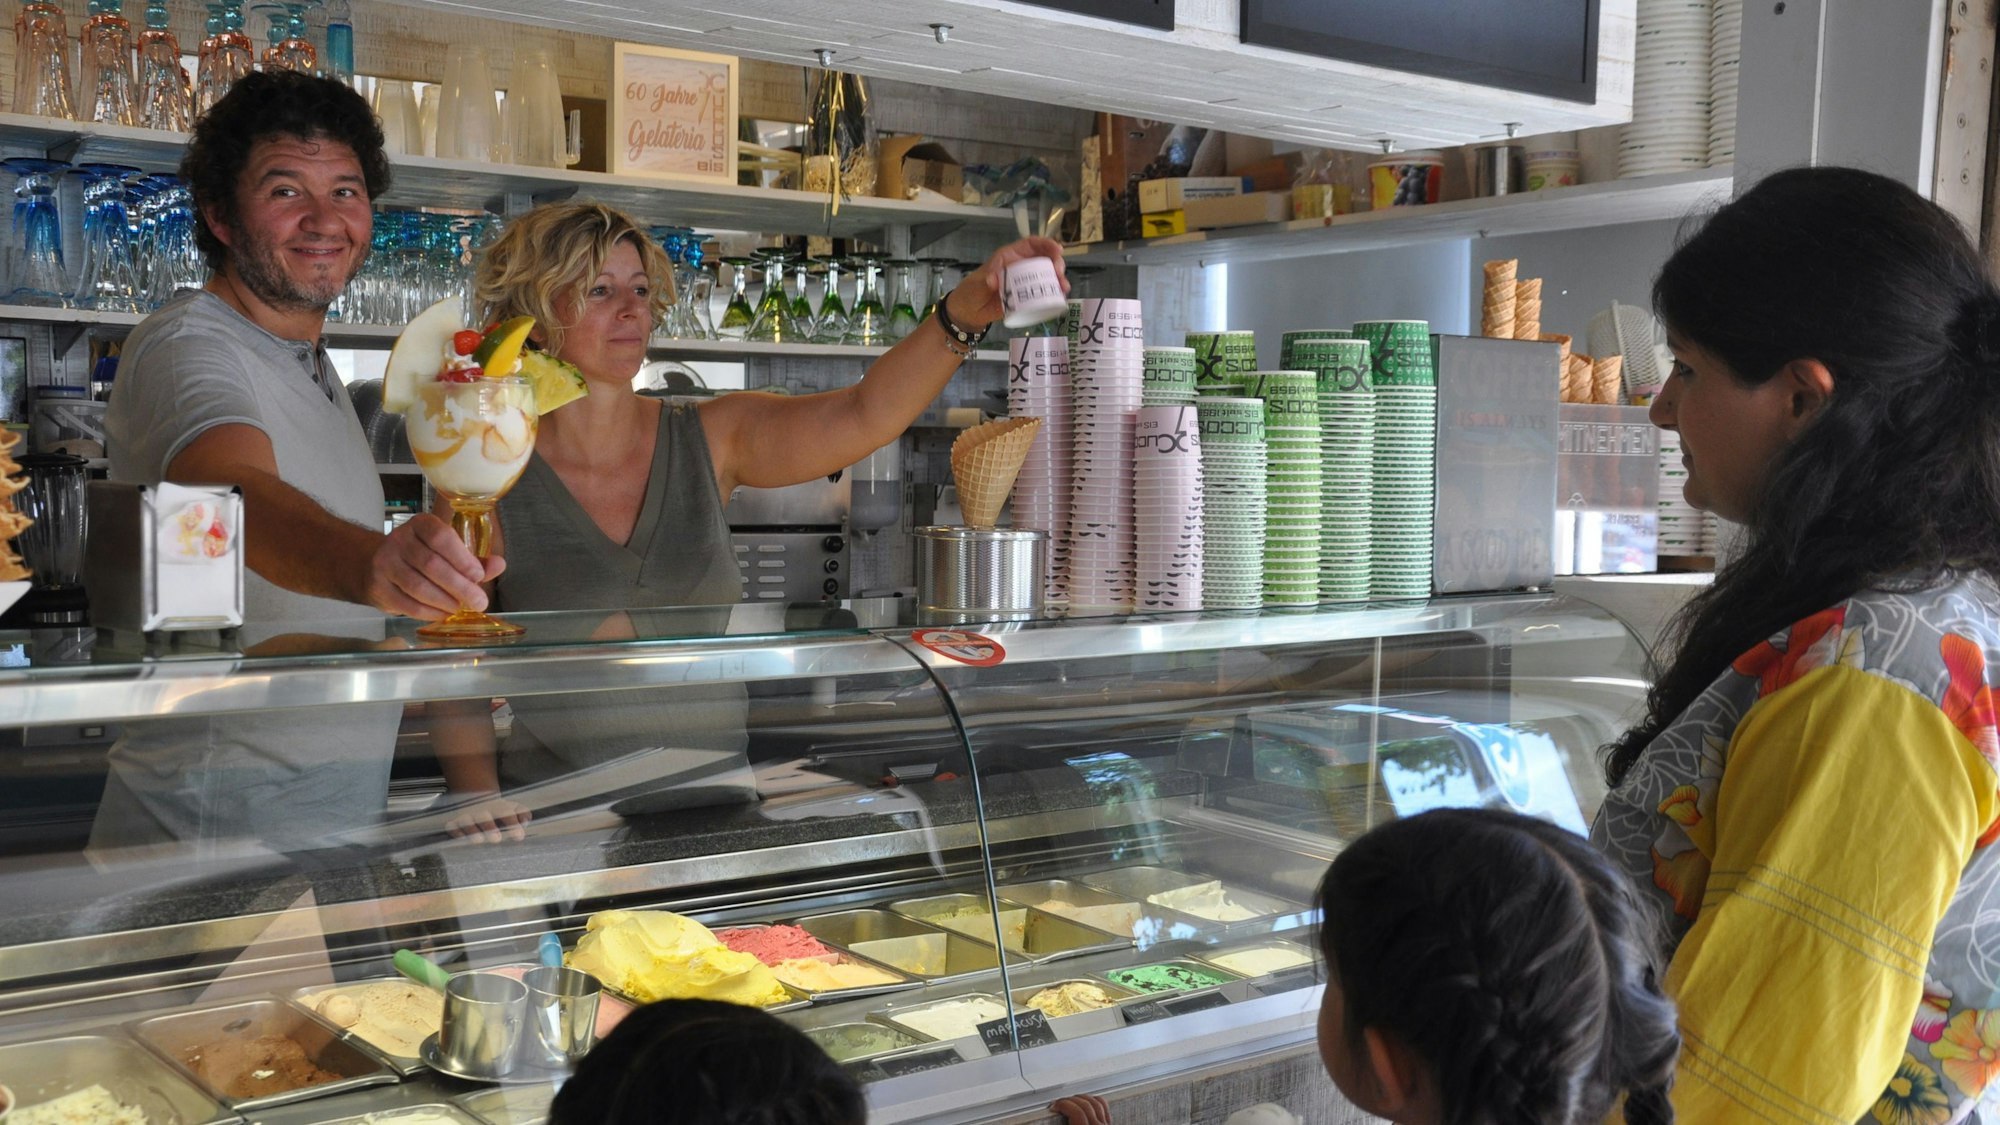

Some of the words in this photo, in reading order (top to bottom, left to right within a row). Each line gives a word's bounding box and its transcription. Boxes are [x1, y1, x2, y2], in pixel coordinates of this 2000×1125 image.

[625, 81, 647, 101] 60
[650, 83, 698, 113] Jahre
[627, 119, 706, 162] Gelateria
[697, 159, 724, 173] eis
[1318, 353, 1339, 362] EIS
[1144, 369, 1196, 383] UCCO
[1244, 409, 1259, 418] EIS
[1143, 421, 1158, 429] EIS
